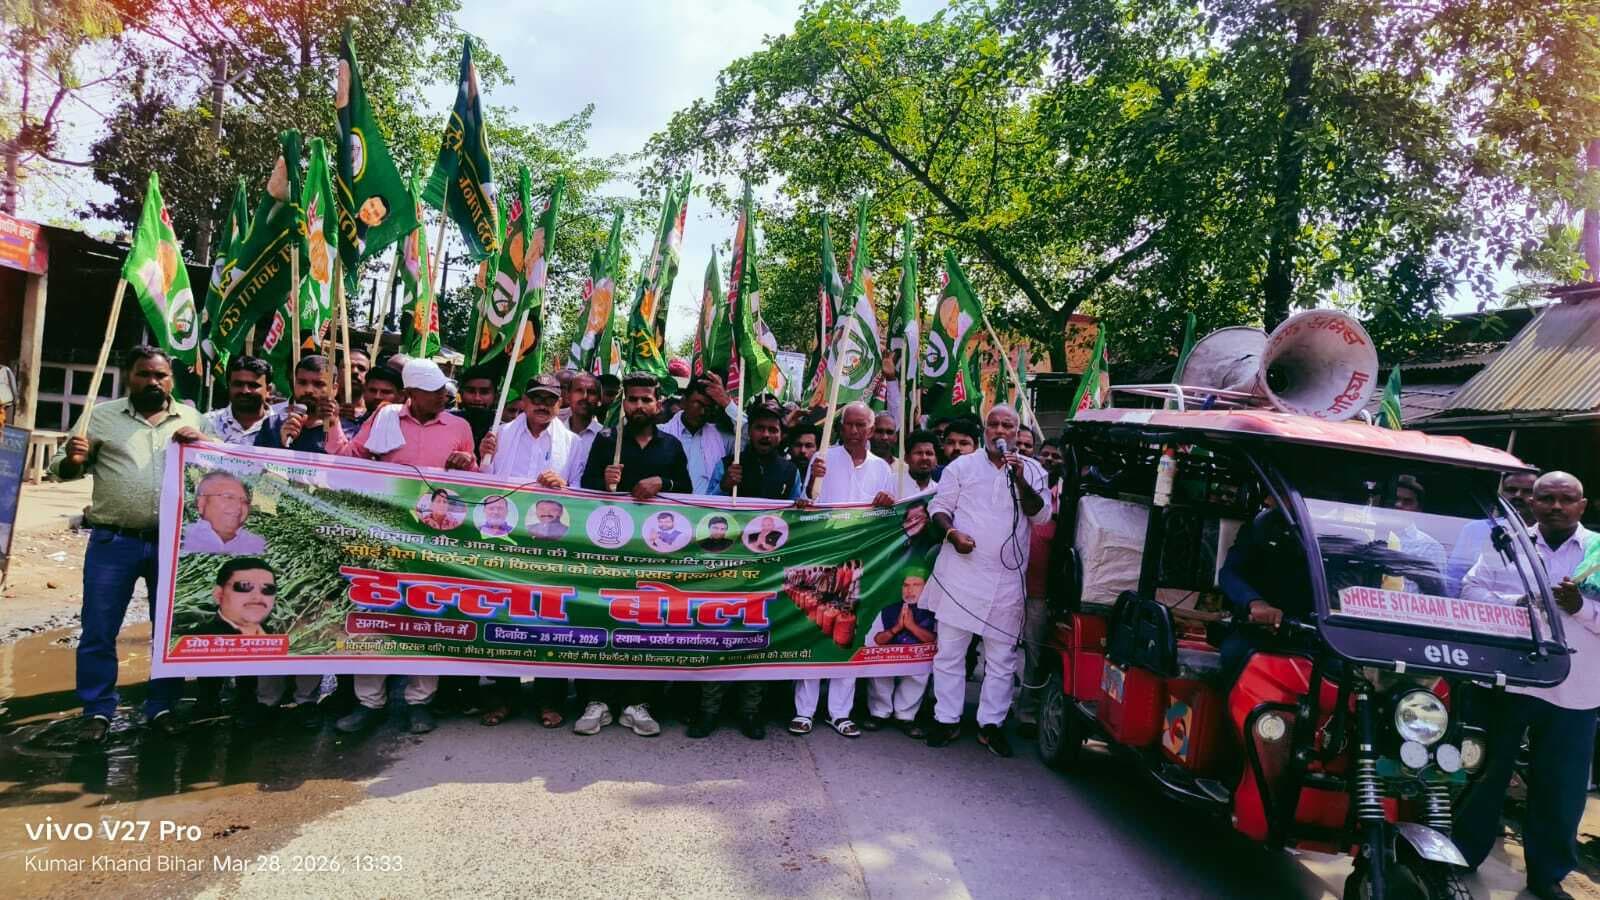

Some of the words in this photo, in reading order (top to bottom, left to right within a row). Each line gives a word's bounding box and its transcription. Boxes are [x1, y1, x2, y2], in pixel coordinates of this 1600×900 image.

[339, 566, 576, 622] हल्ला
[598, 581, 778, 626] बोल
[1343, 587, 1388, 610] SHREE
[1390, 592, 1449, 618] SITARAM
[579, 634, 600, 645] 2026
[1424, 643, 1469, 667] ele
